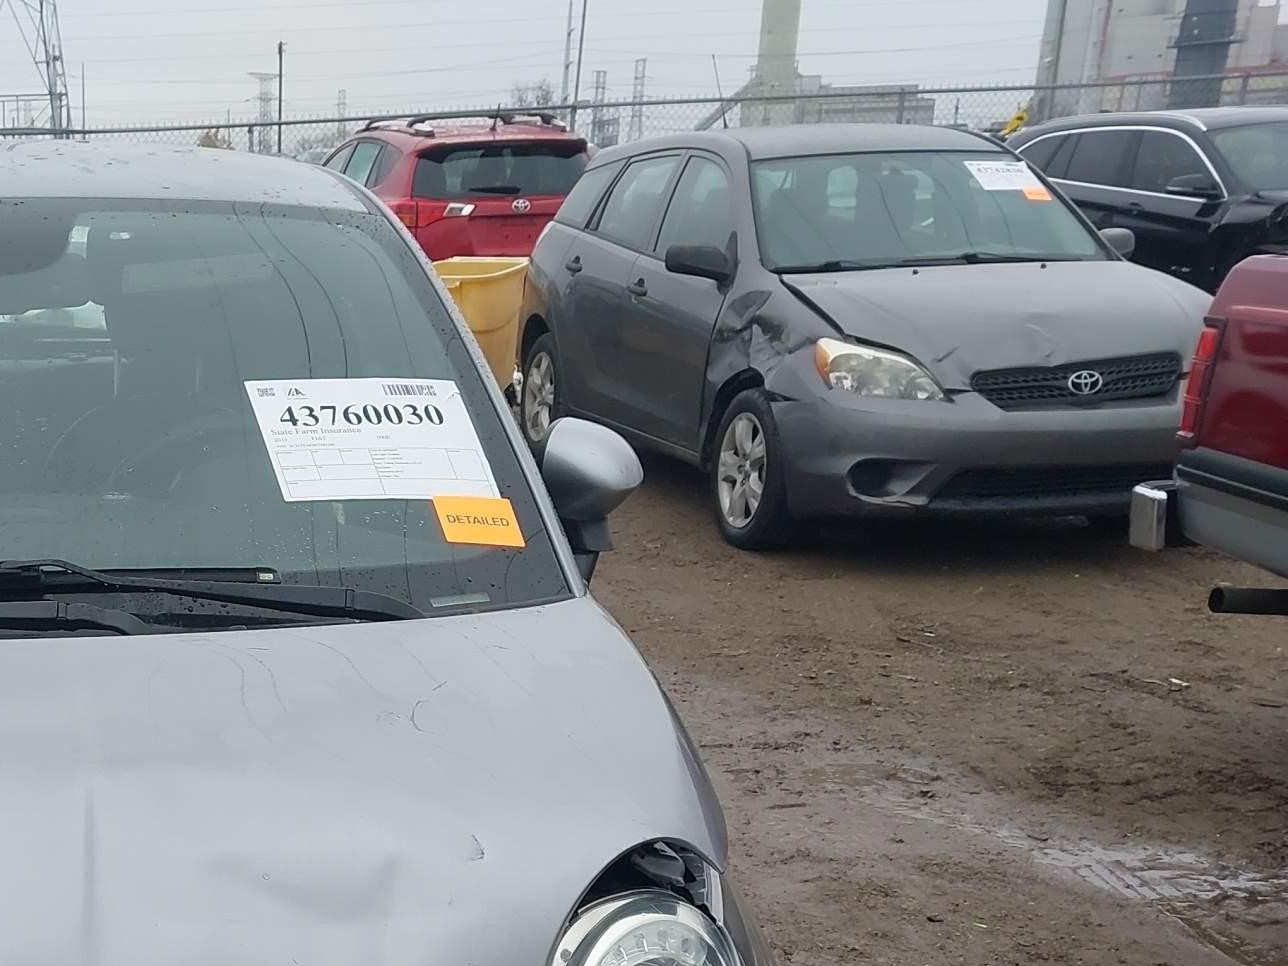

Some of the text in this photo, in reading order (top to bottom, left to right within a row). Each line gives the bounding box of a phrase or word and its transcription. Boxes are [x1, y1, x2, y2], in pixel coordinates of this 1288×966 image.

[280, 404, 444, 426] 43760030
[321, 427, 362, 435] Insurance
[446, 514, 510, 527] DETAILED
